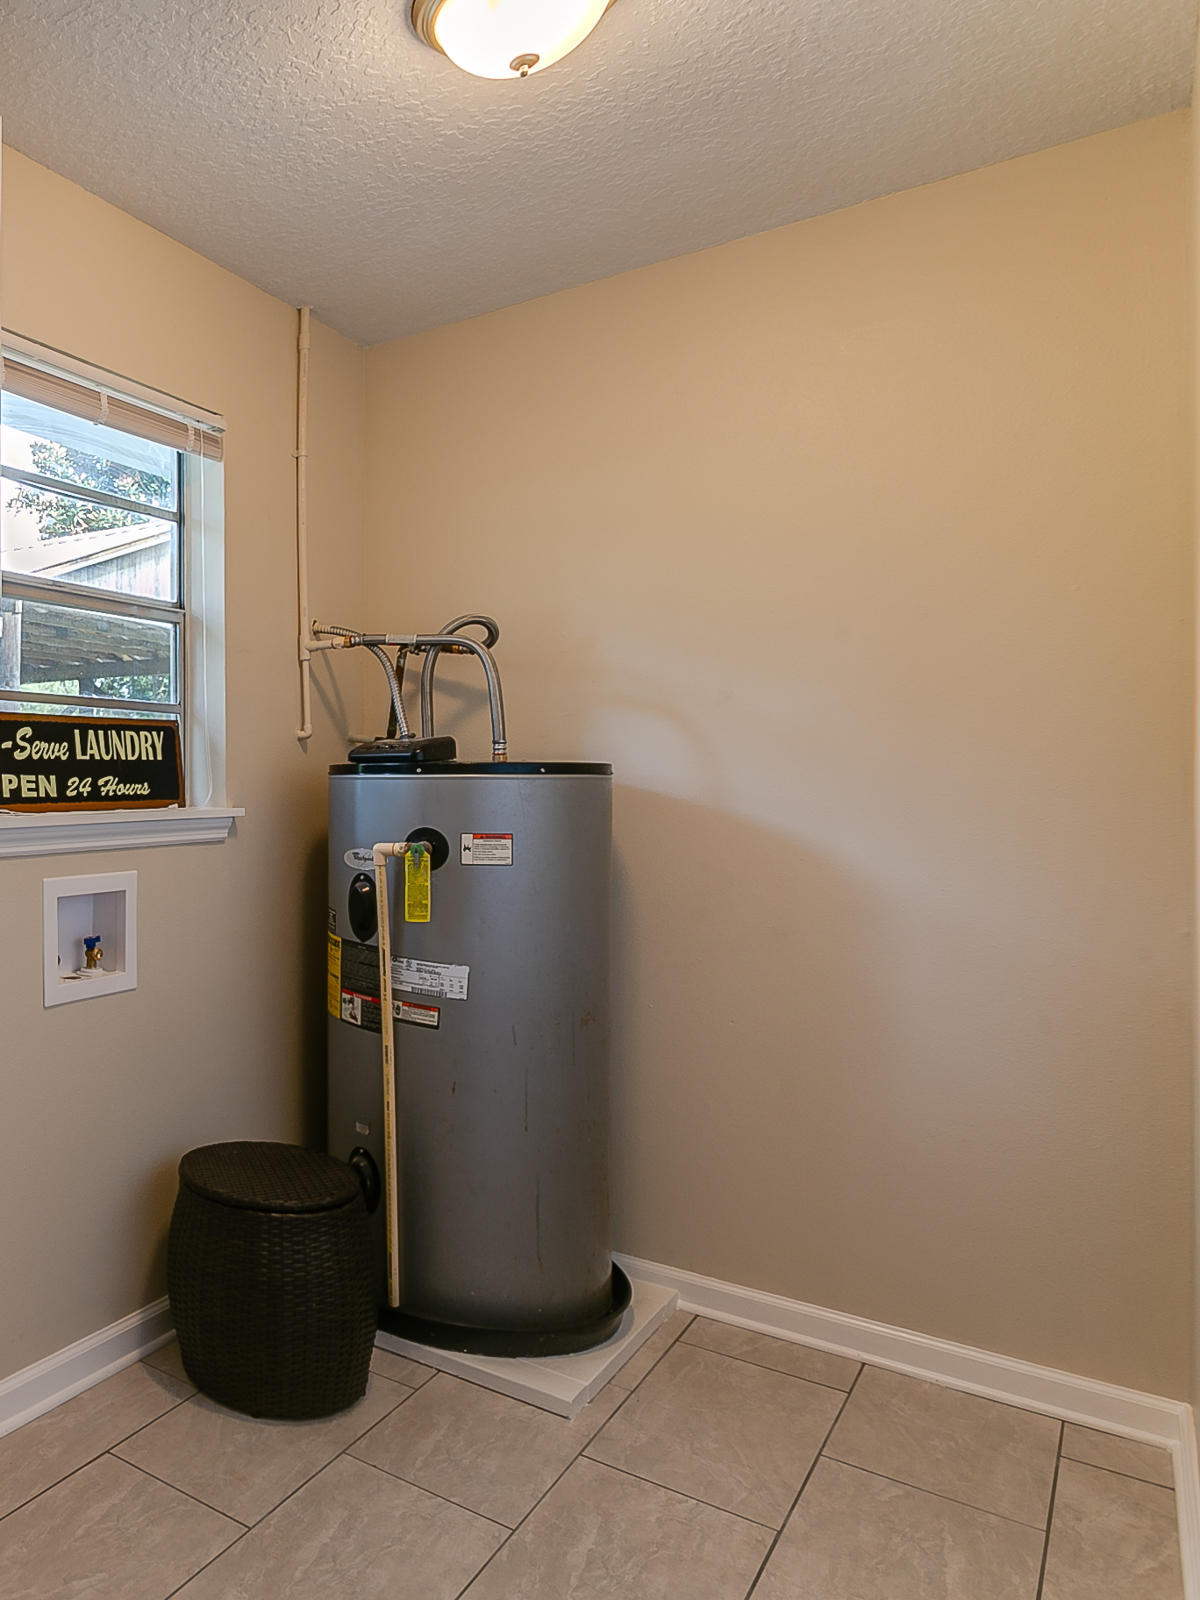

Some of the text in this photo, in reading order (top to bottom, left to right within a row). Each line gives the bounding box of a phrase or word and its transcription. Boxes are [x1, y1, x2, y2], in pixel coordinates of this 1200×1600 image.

[74, 729, 164, 761] LAUNDRY
[66, 777, 92, 796] 24
[98, 776, 151, 795] Hours
